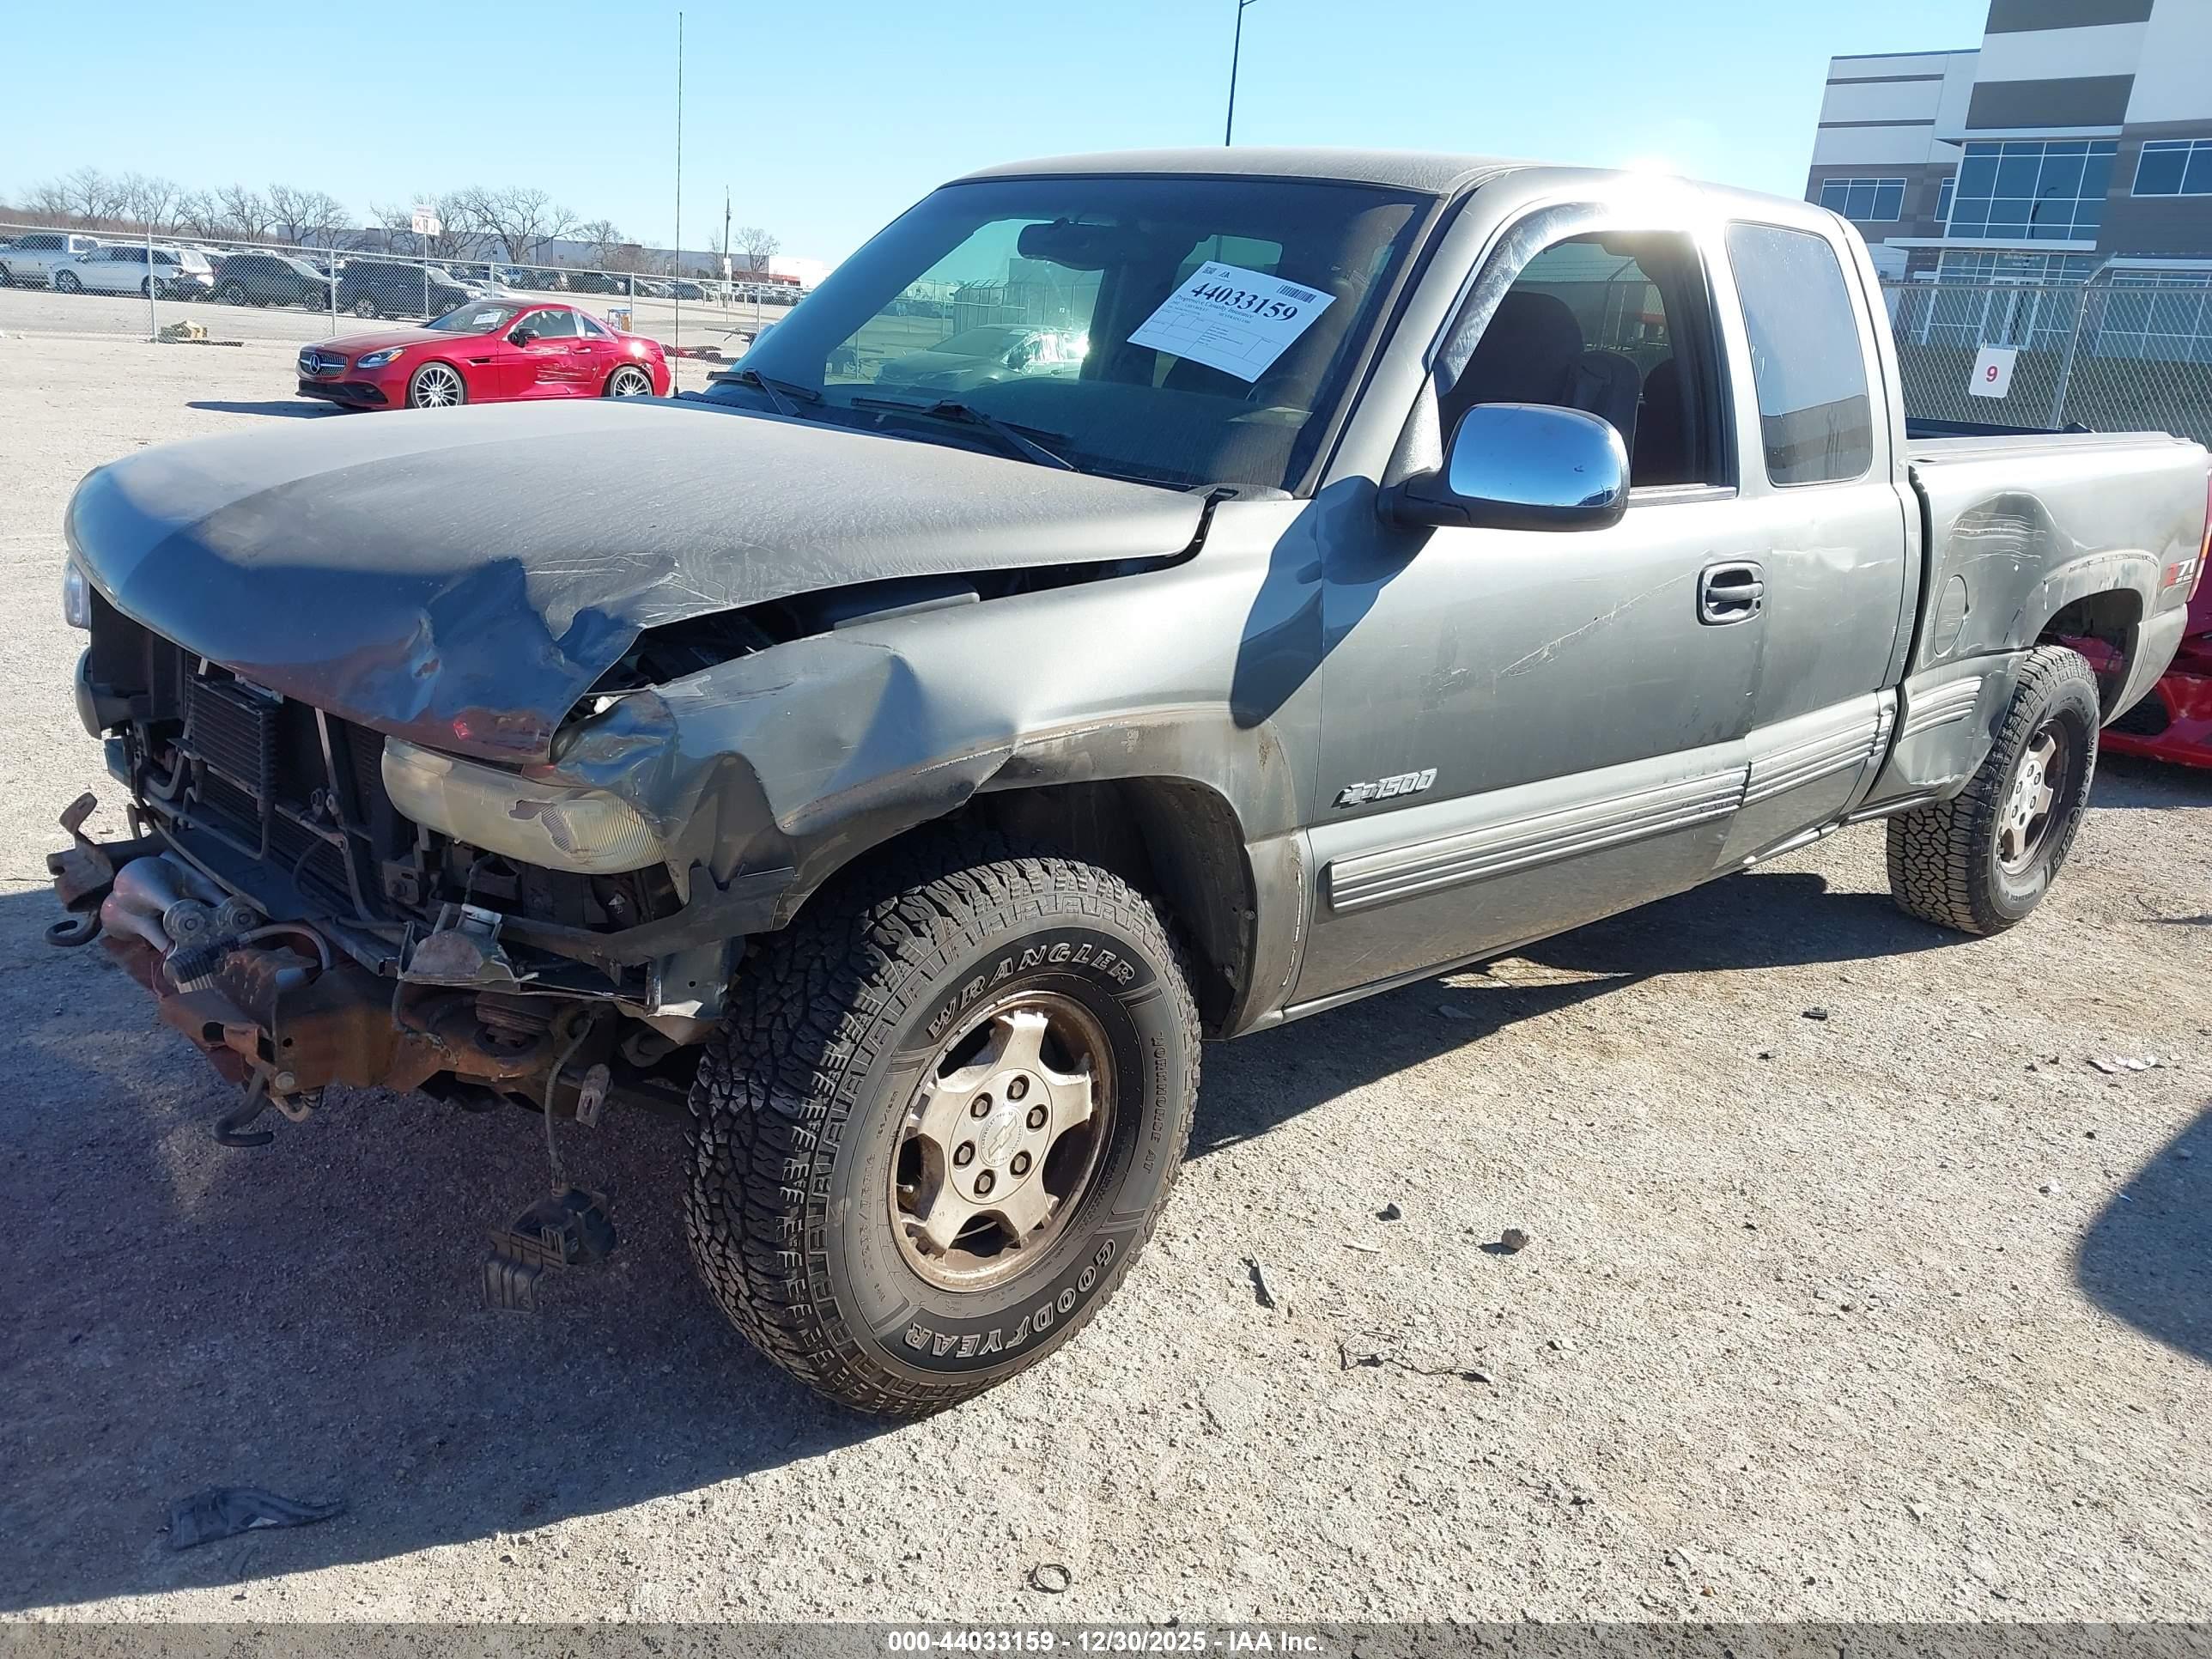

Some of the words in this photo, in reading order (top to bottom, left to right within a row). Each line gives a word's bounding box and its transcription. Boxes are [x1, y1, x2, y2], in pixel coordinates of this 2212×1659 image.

[1191, 283, 1298, 320] 44033159
[1228, 308, 1254, 319] Insurance
[1985, 366, 1998, 382] 9
[1375, 768, 1437, 799] 1500
[927, 941, 1137, 1041] WRANGLER
[904, 1239, 1117, 1358] GOODYEAR
